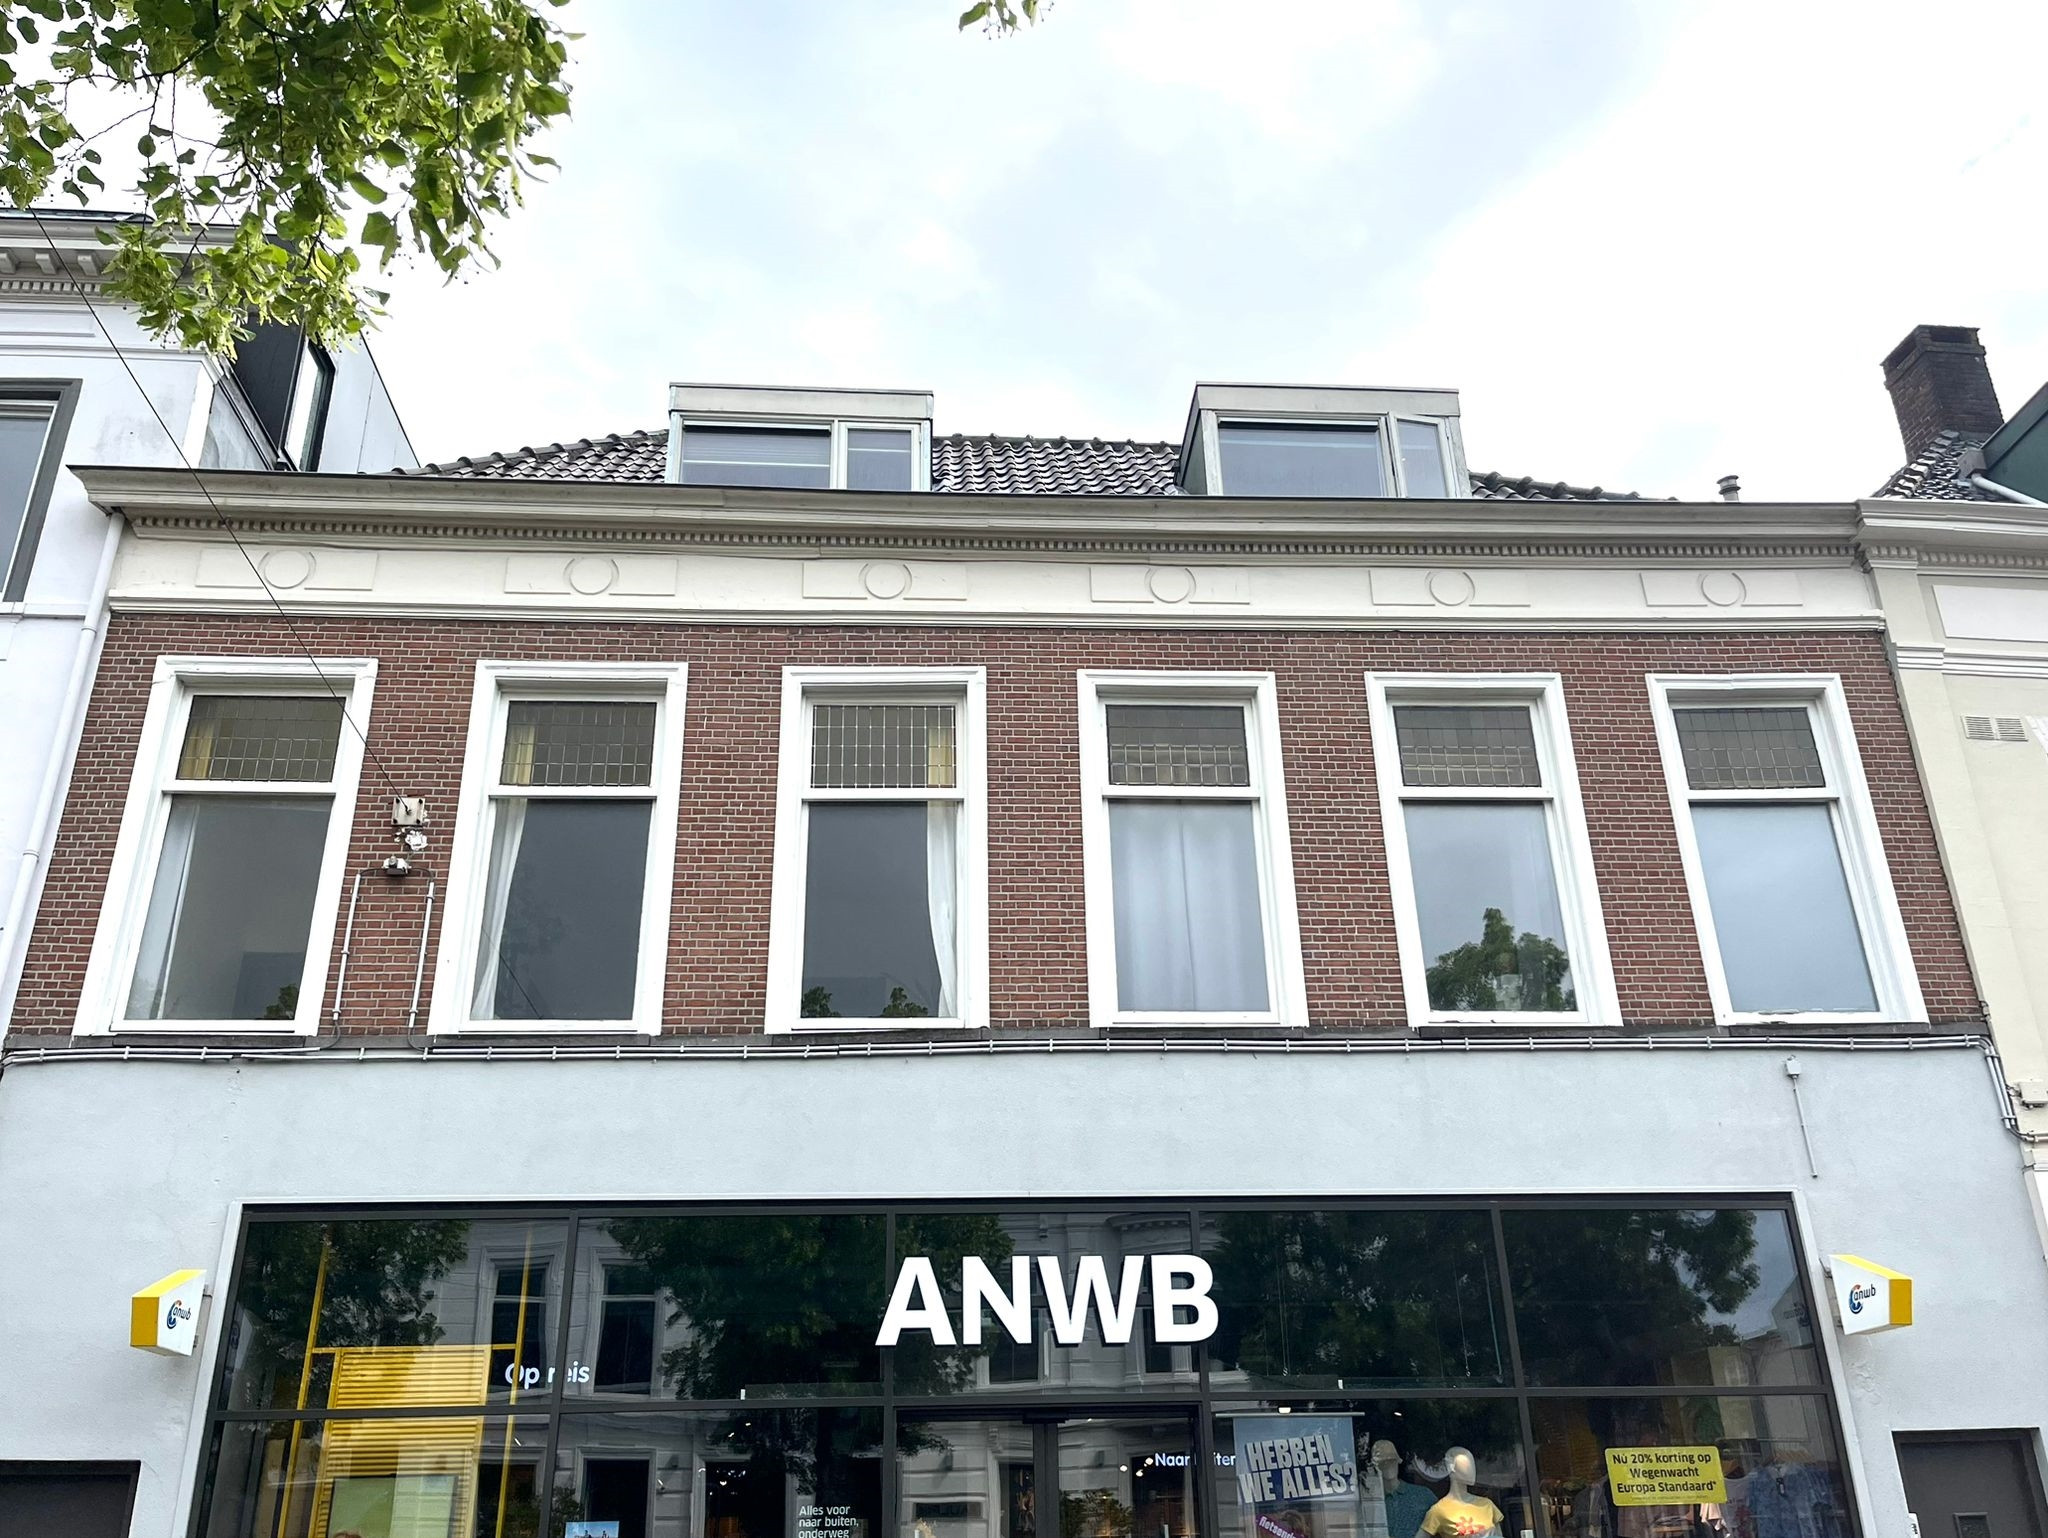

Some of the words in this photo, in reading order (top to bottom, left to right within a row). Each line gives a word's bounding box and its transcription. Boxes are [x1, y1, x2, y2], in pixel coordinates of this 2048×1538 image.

[875, 1254, 1219, 1346] ANWB
[505, 1362, 540, 1389] Op
[1154, 1452, 1190, 1467] Naar
[1245, 1434, 1334, 1472] HEBBEN
[1632, 1453, 1653, 1464] 20%
[1655, 1452, 1695, 1465] korting
[1697, 1453, 1711, 1464] op
[1630, 1467, 1700, 1479] Wegenwacht
[1239, 1471, 1277, 1503] WE
[1281, 1462, 1356, 1500] ALLES?
[1617, 1482, 1656, 1495] Europa
[799, 1505, 824, 1516] Alles
[826, 1506, 851, 1515] voor
[799, 1518, 822, 1528] naar
[824, 1515, 859, 1527] buiten,
